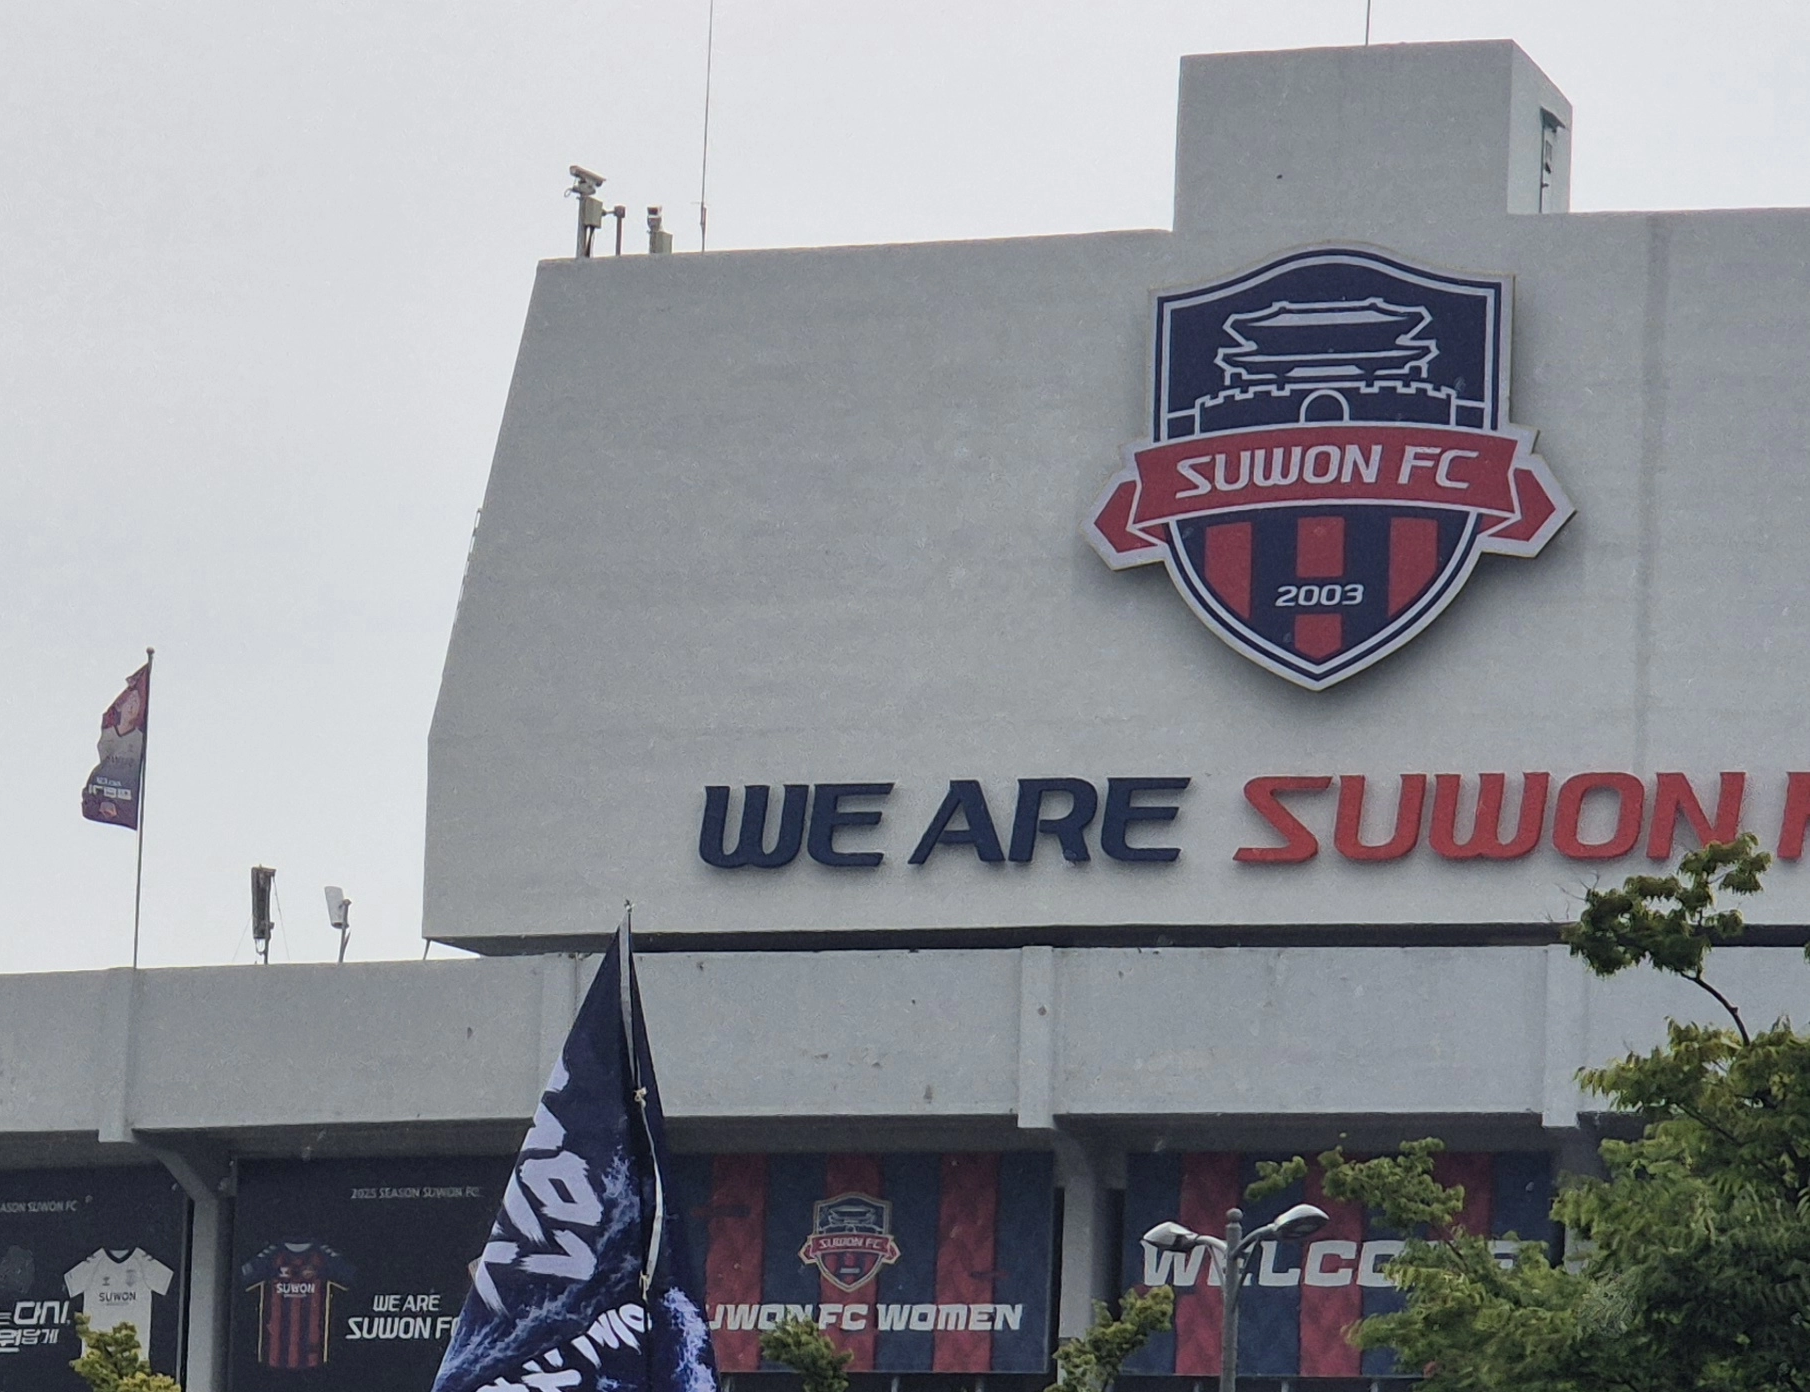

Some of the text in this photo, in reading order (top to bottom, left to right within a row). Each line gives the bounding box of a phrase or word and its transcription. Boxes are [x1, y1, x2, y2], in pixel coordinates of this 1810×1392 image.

[1175, 444, 1479, 499] SUWON FC
[1274, 583, 1365, 606] 2003
[698, 782, 895, 867] WE
[907, 777, 1191, 864] ARE
[1232, 771, 1746, 862] SUWON
[379, 1187, 420, 1199] SEASON
[422, 1186, 463, 1198] SUWON
[27, 1201, 64, 1213] SUWON
[64, 1200, 77, 1212] FC
[818, 1236, 882, 1250] SUWON FC
[97, 1291, 137, 1303] SUWON
[276, 1283, 316, 1295] SUWON
[372, 1294, 441, 1312] WE ARE
[706, 1304, 1023, 1332] UWON FC WOMEN
[345, 1316, 432, 1340] SUWON
